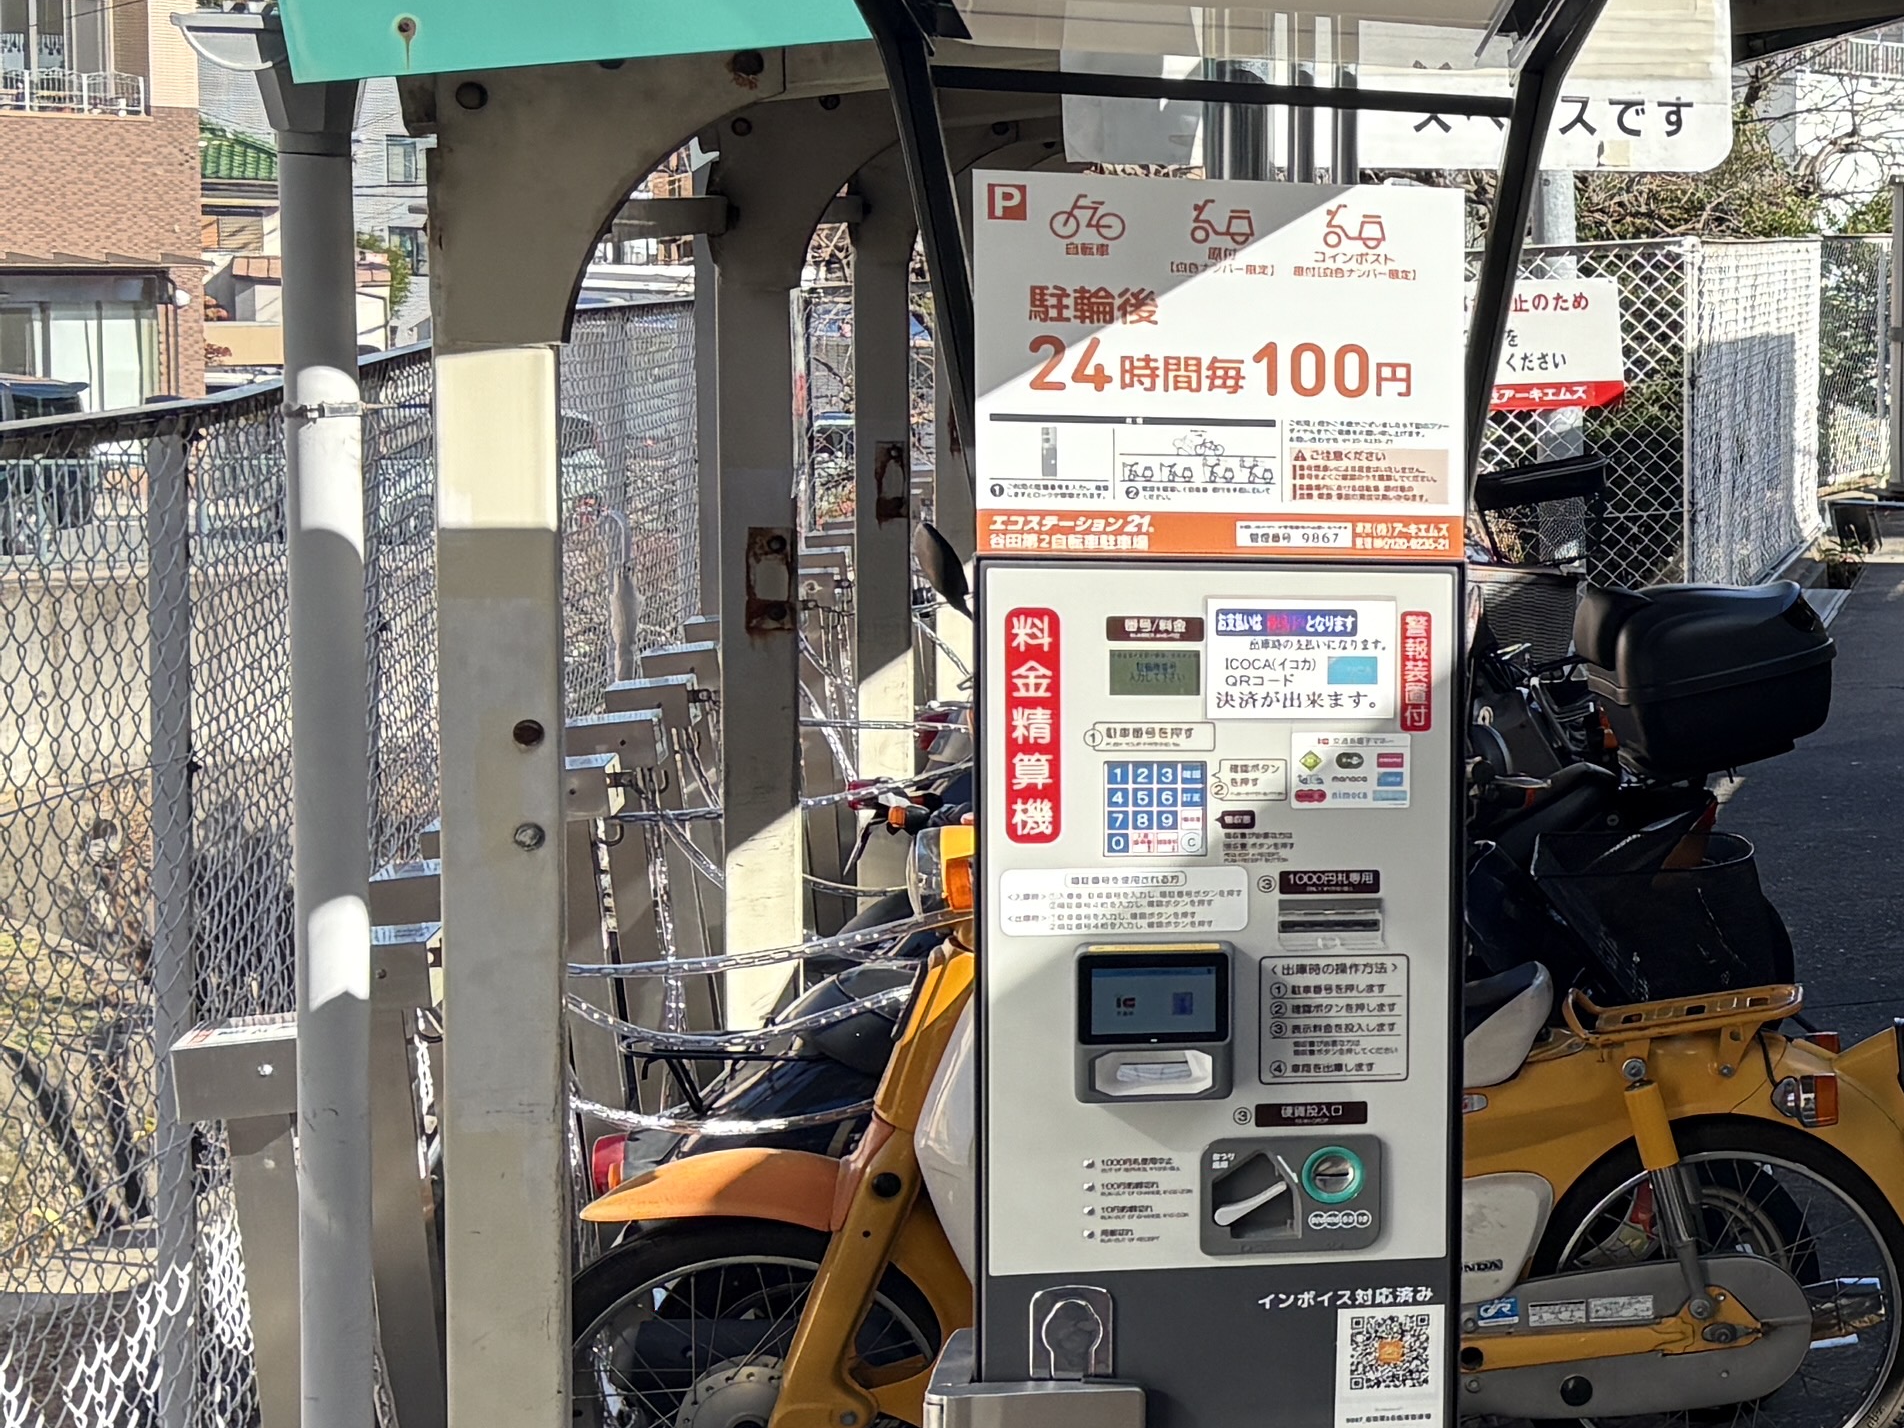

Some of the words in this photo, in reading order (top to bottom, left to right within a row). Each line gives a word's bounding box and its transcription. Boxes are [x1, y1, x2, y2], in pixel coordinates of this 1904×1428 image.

[994, 186, 1021, 217] P
[1066, 243, 1110, 256] 自転車
[1029, 285, 1158, 325] 駐輪後
[1028, 335, 1413, 398] 24時間毎100円
[1302, 532, 1340, 544] 9867
[1405, 615, 1428, 726] 警報装置付
[1225, 674, 1294, 687] QRコード
[1216, 692, 1377, 708] 決済が出来ます。
[1011, 615, 1053, 836] 料金精算機
[1113, 768, 1122, 782] 1
[1137, 769, 1149, 782] 2
[1161, 768, 1173, 782] 3
[1112, 791, 1123, 805] 4
[1137, 791, 1149, 805] 5
[1161, 791, 1173, 805] 6
[1112, 814, 1123, 827] 7
[1137, 813, 1149, 827] 8
[1161, 813, 1173, 827] 9
[1112, 836, 1124, 850] 0
[1187, 837, 1196, 847] C
[1288, 873, 1373, 885] 1000円札専用
[1281, 1105, 1342, 1117] 硬貨投入口
[1461, 1259, 1503, 1272] NDA
[1258, 1286, 1433, 1309] インボイス対応済み
